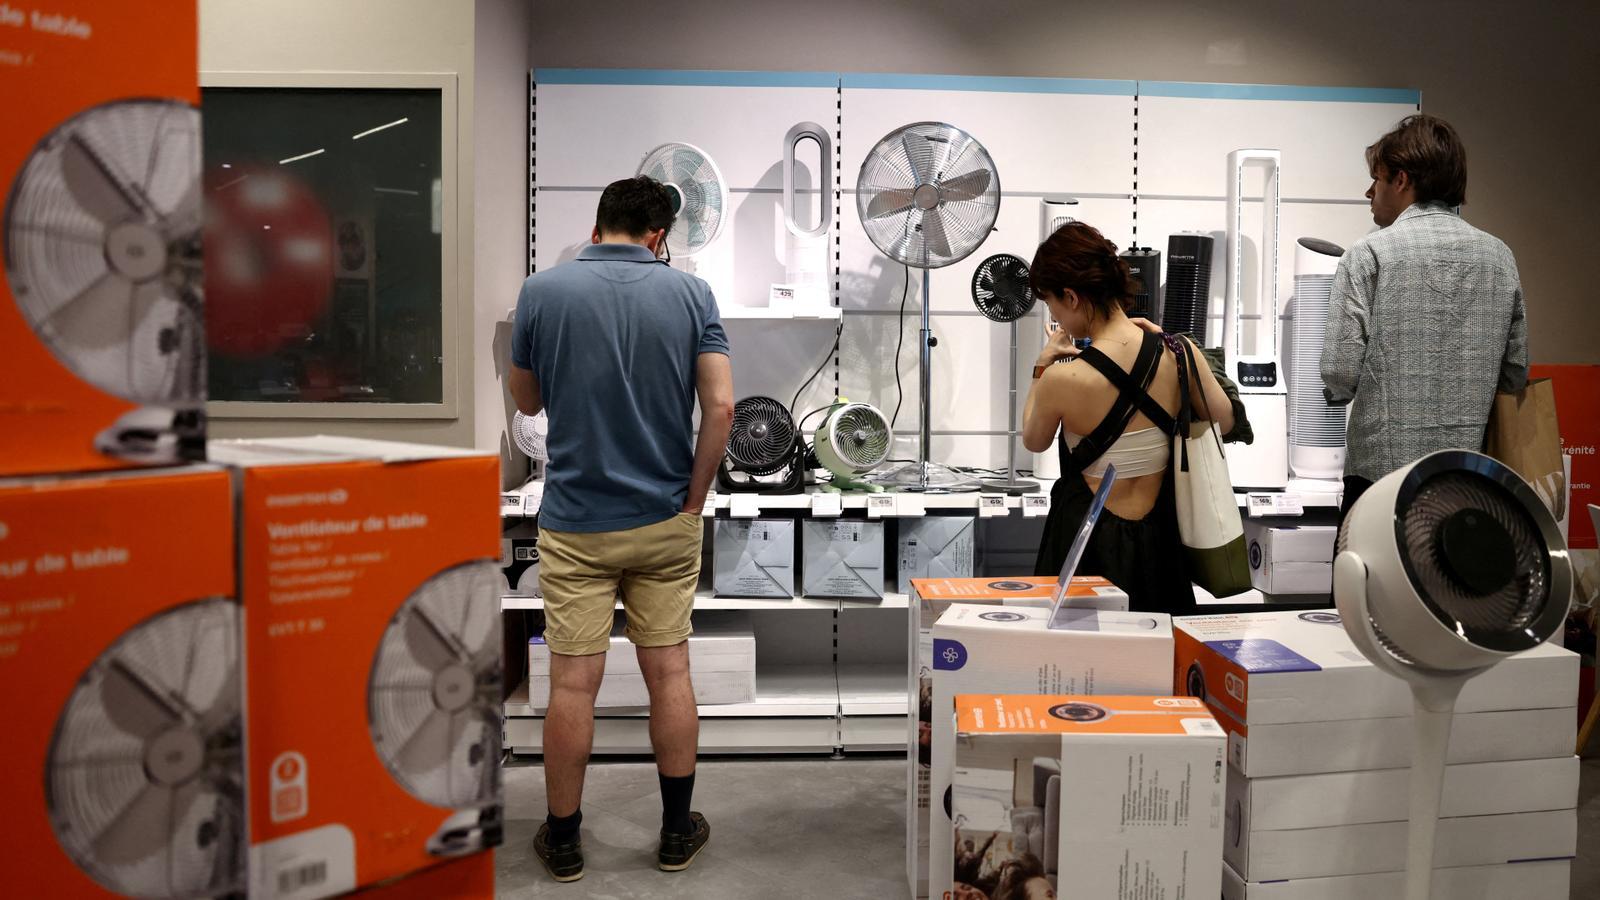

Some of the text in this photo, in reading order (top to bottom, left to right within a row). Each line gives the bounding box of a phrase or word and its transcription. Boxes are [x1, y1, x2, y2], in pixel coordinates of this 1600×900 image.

[30, 10, 92, 39] table
[1561, 445, 1595, 455] rénité
[267, 512, 428, 539] Ventilateur de table
[35, 553, 66, 574] de
[72, 547, 129, 570] table
